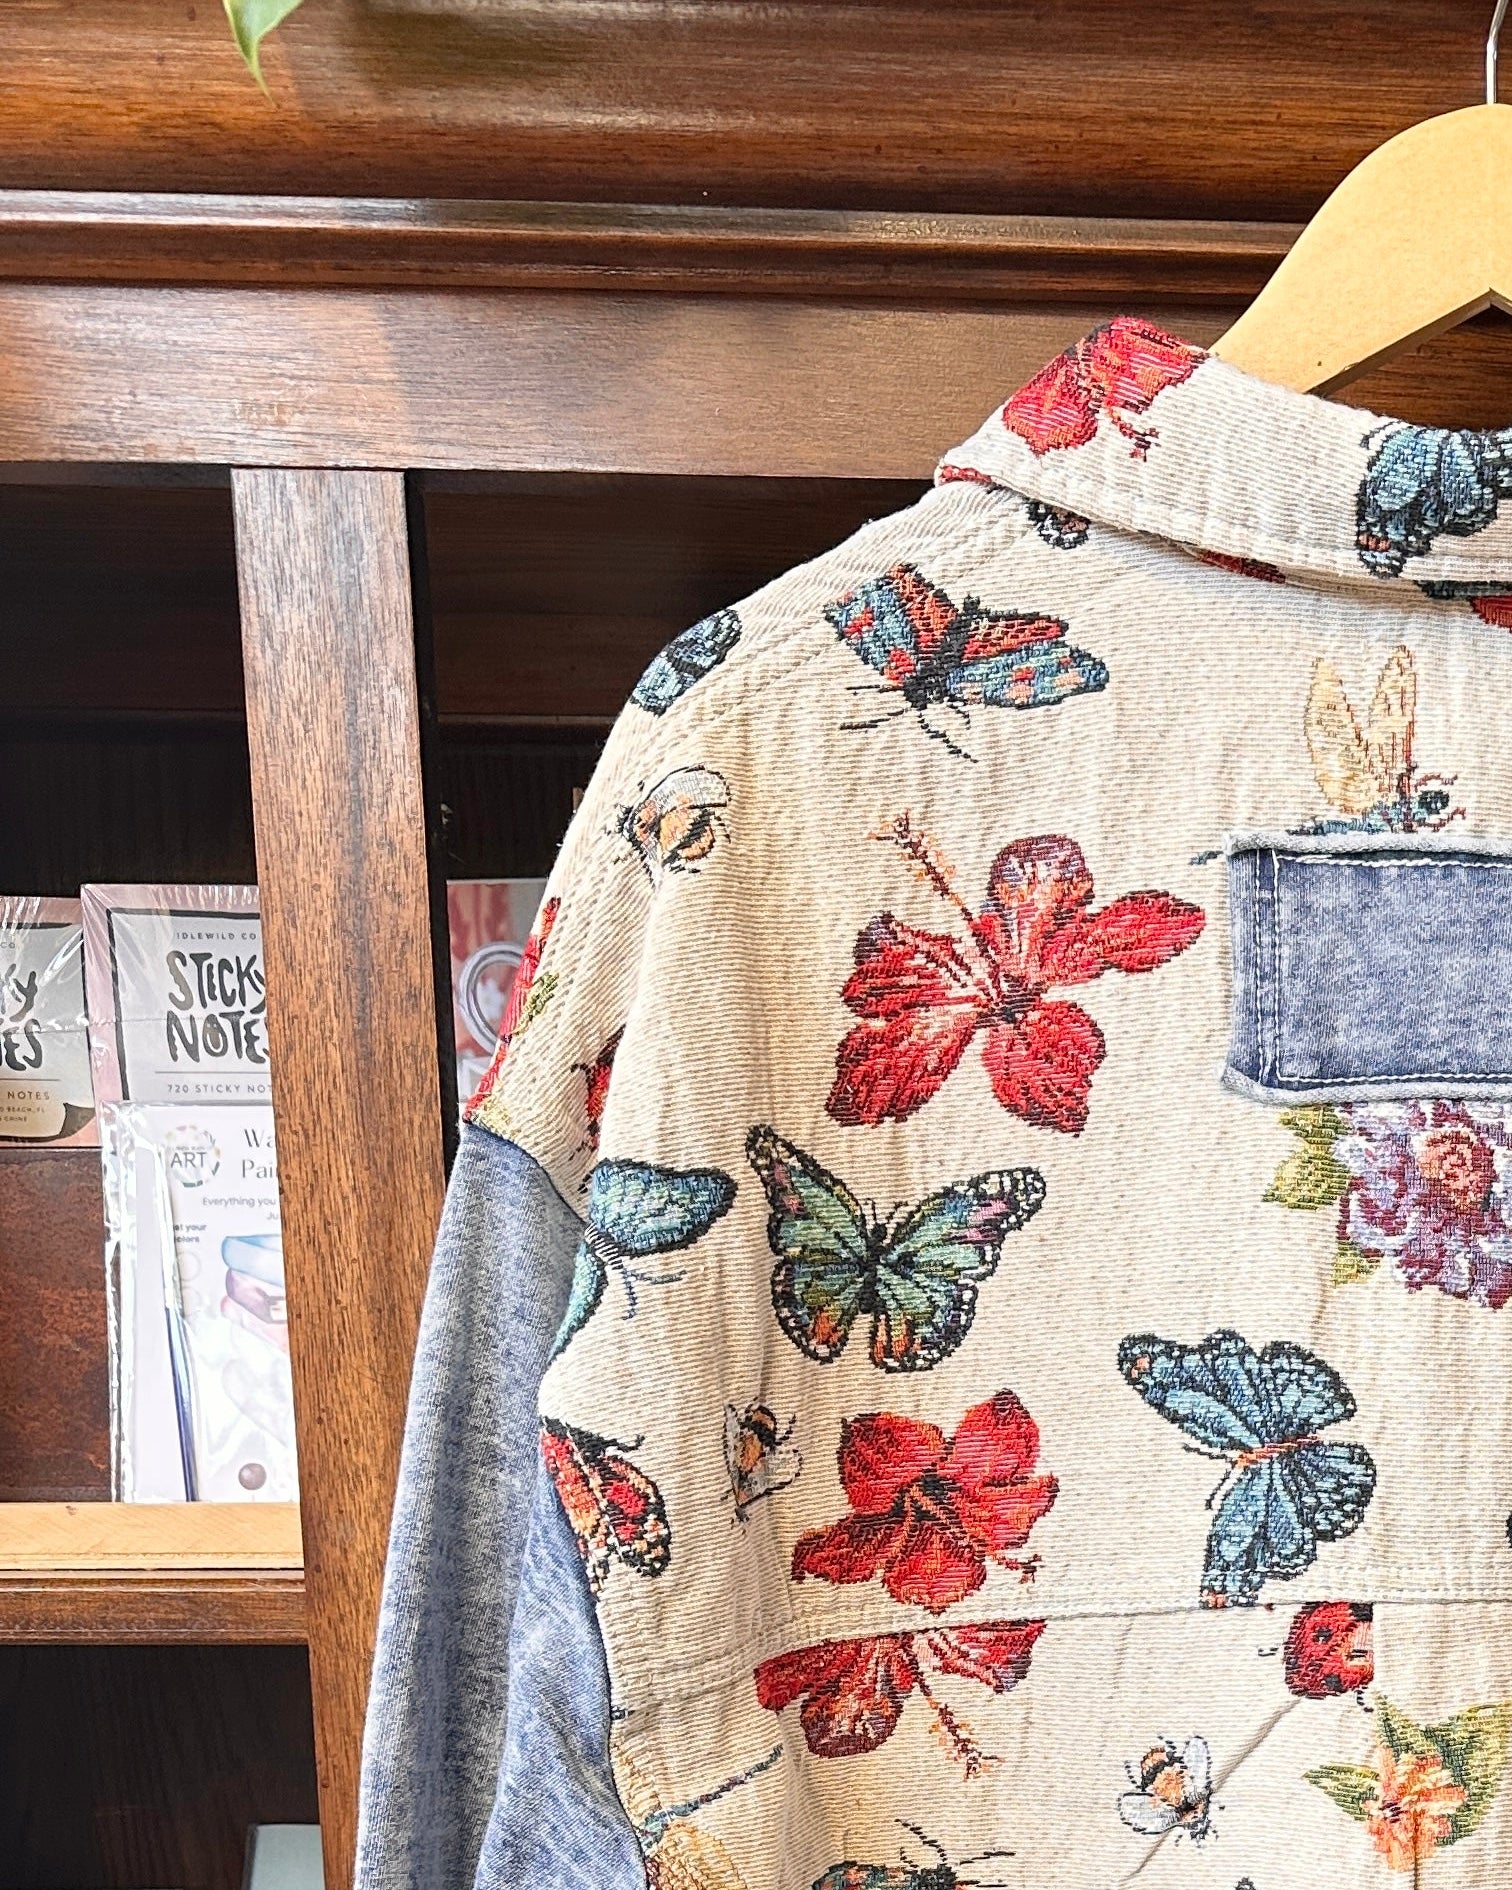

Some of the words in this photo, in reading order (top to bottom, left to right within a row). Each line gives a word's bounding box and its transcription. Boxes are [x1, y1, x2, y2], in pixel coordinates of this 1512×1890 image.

[176, 932, 235, 940] IDLEWILD
[167, 1084, 189, 1093] 720
[195, 1084, 241, 1094] STICKY
[7, 1090, 50, 1100] NOTES
[171, 1152, 207, 1168] ART
[202, 1197, 256, 1208] Everything
